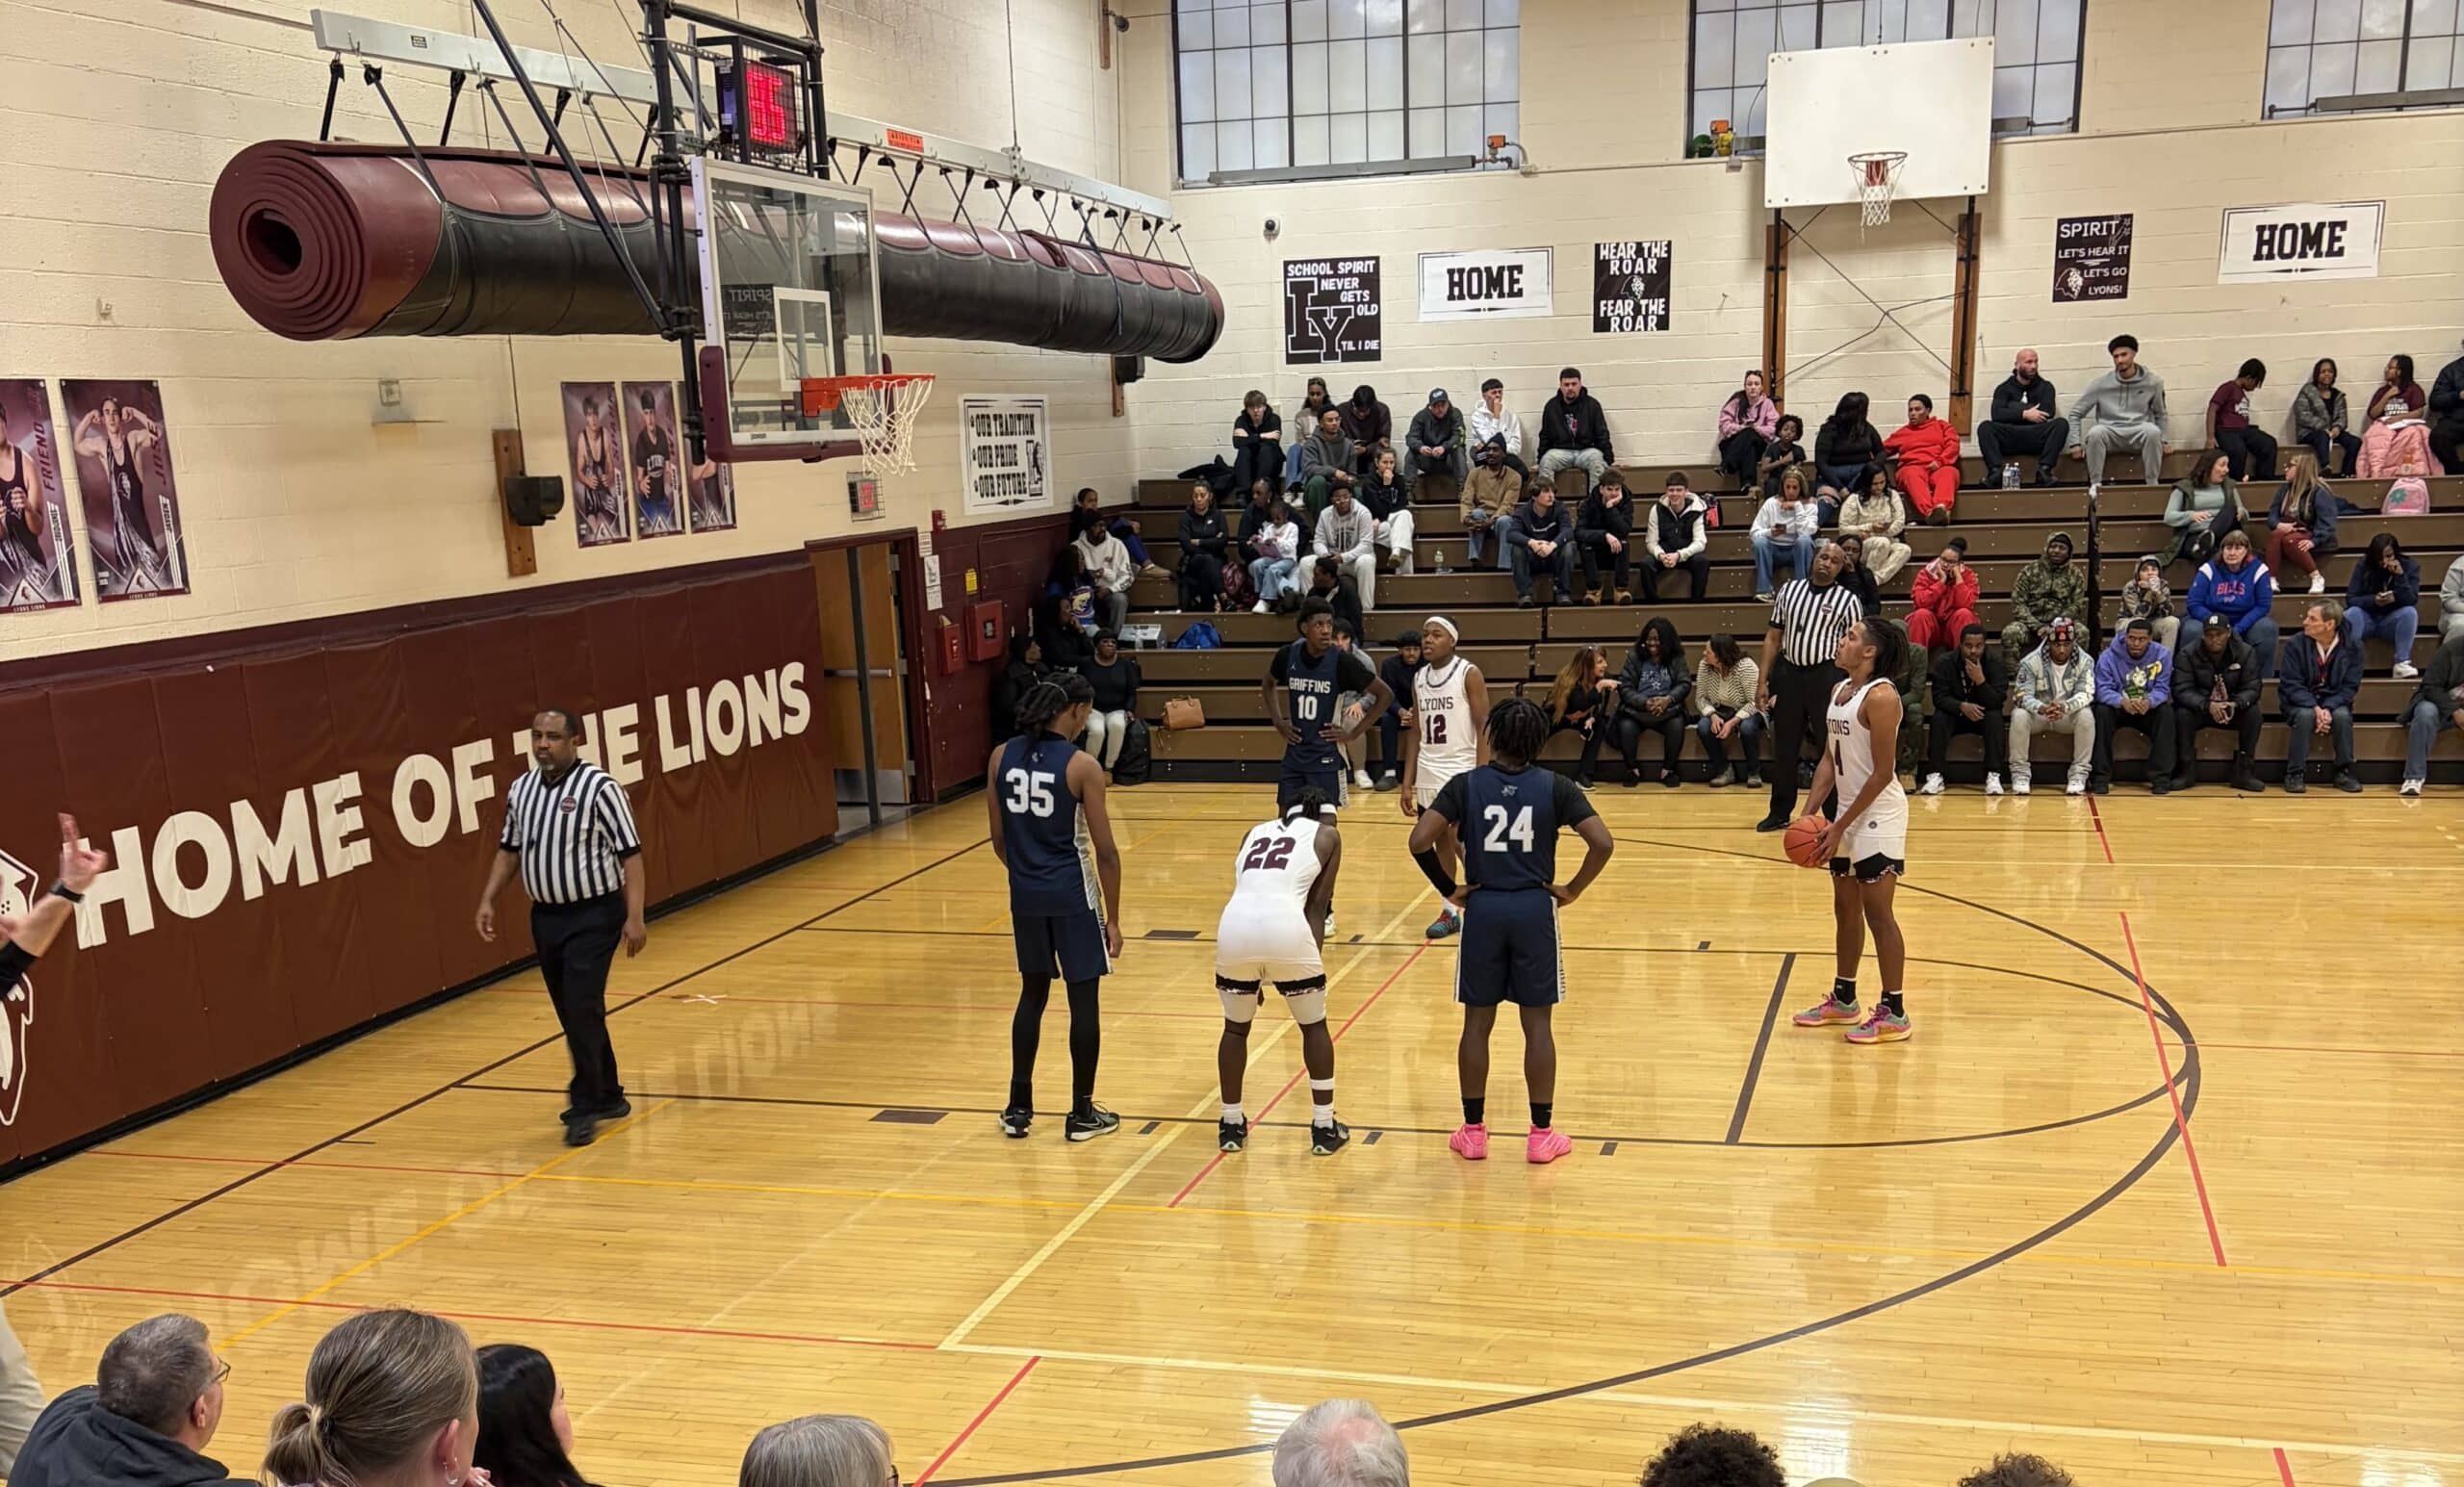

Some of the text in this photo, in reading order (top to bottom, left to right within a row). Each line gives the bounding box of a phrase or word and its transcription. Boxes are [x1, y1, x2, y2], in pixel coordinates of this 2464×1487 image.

[2060, 220, 2119, 239] SPIRIT
[1600, 241, 1668, 261] HEAR THE
[2253, 220, 2348, 262] HOME
[2058, 244, 2129, 259] LET'S HEAR IT
[1287, 260, 1376, 276] SCHOOL SPIRIT
[1609, 258, 1657, 276] ROAR
[2083, 267, 2127, 278] LET'S GO
[1321, 276, 1360, 291] NEVER
[1446, 264, 1524, 301] HOME
[2088, 285, 2122, 295] LYONS!
[1340, 290, 1371, 303] GETS
[1356, 303, 1378, 317] OLD
[1600, 297, 1666, 318] FEAR THE
[1609, 314, 1657, 332] ROAR
[1358, 340, 1362, 350] I
[1364, 340, 1379, 350] DIE
[975, 413, 1035, 438] OUR TRADITION
[33, 421, 55, 492] FRIEND
[977, 444, 1018, 469] OUR PRIDE
[979, 472, 1028, 499] OUR FUTURE
[1289, 677, 1331, 694] GRIFFINS
[1297, 694, 1318, 721] 10
[1420, 696, 1454, 712] LYONS
[1425, 713, 1448, 745] 12
[1005, 767, 1056, 818] 35
[63, 771, 372, 950] HOME
[392, 737, 496, 848] OF
[654, 661, 811, 775] LIONS
[1483, 804, 1535, 853] 24
[1241, 836, 1296, 874] 22
